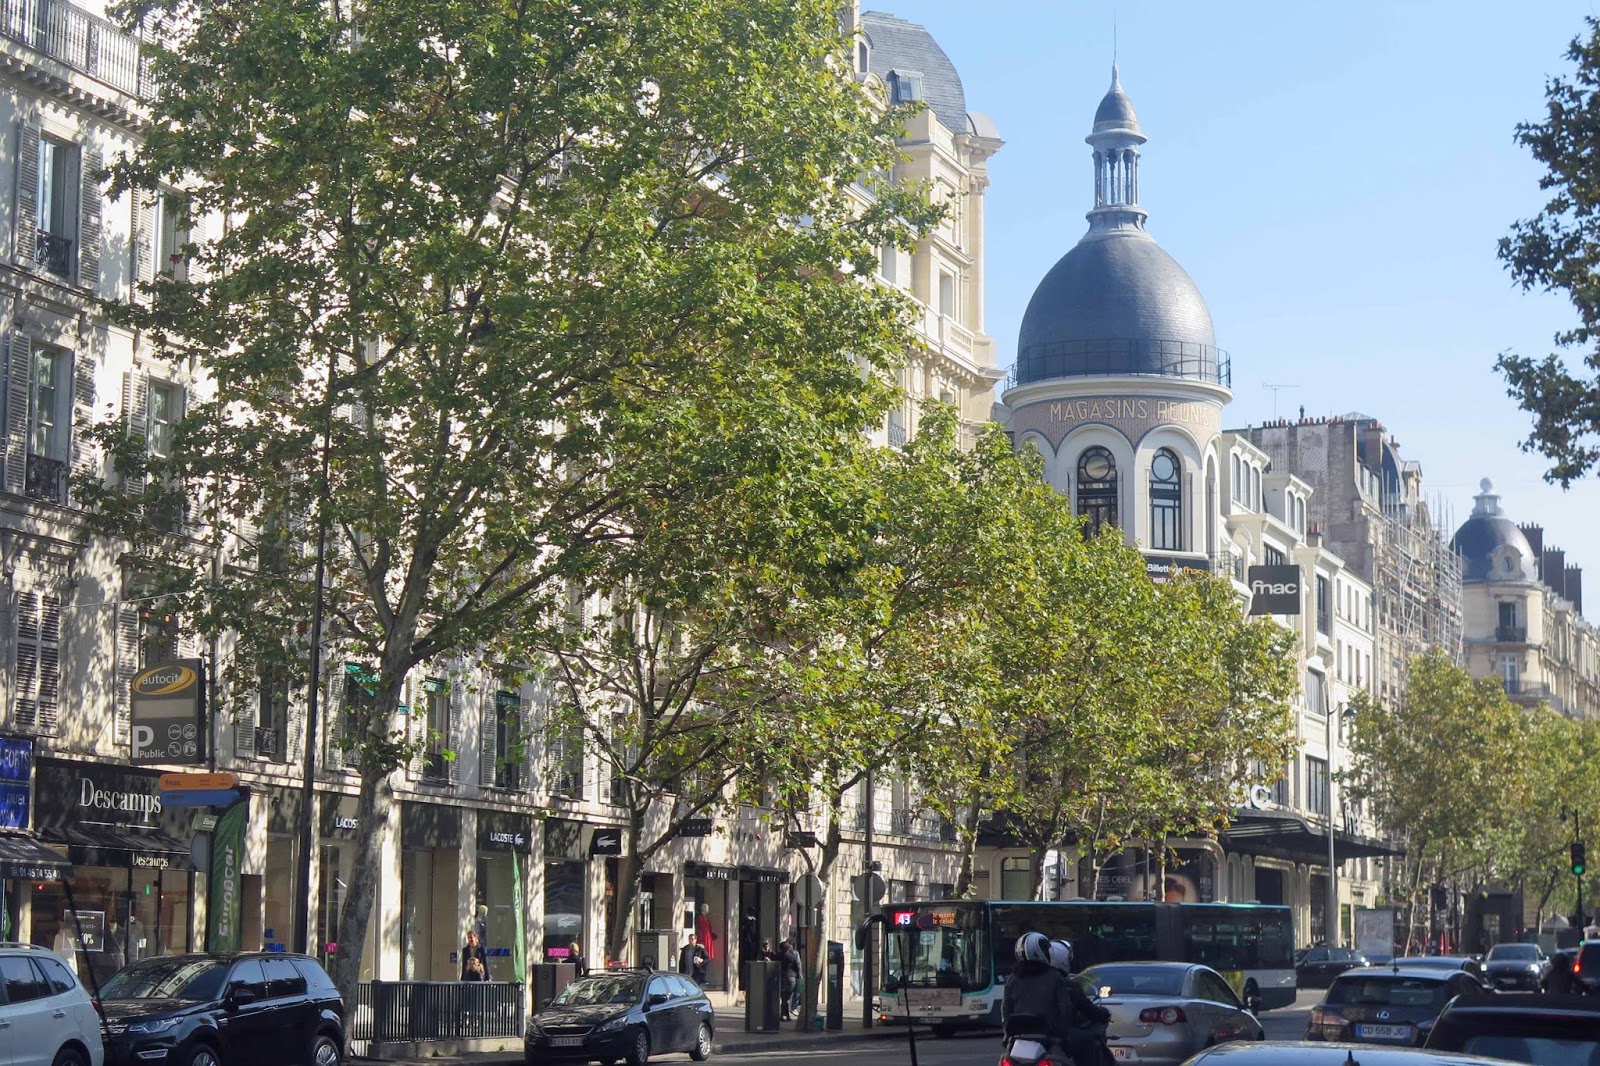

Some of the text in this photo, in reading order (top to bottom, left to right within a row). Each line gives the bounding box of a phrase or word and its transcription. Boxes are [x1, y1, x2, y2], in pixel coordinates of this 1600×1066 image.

[1050, 399, 1148, 423] MAGASINS
[1146, 563, 1183, 573] Billettie
[1252, 580, 1298, 595] fnac
[132, 725, 155, 759] P
[140, 749, 165, 759] Public
[79, 777, 162, 823] Descamps
[336, 818, 358, 829] LACOS
[490, 832, 513, 844] LACOSTE
[132, 852, 169, 870] Descamps
[218, 844, 235, 937] Europcar
[899, 913, 911, 925] 43
